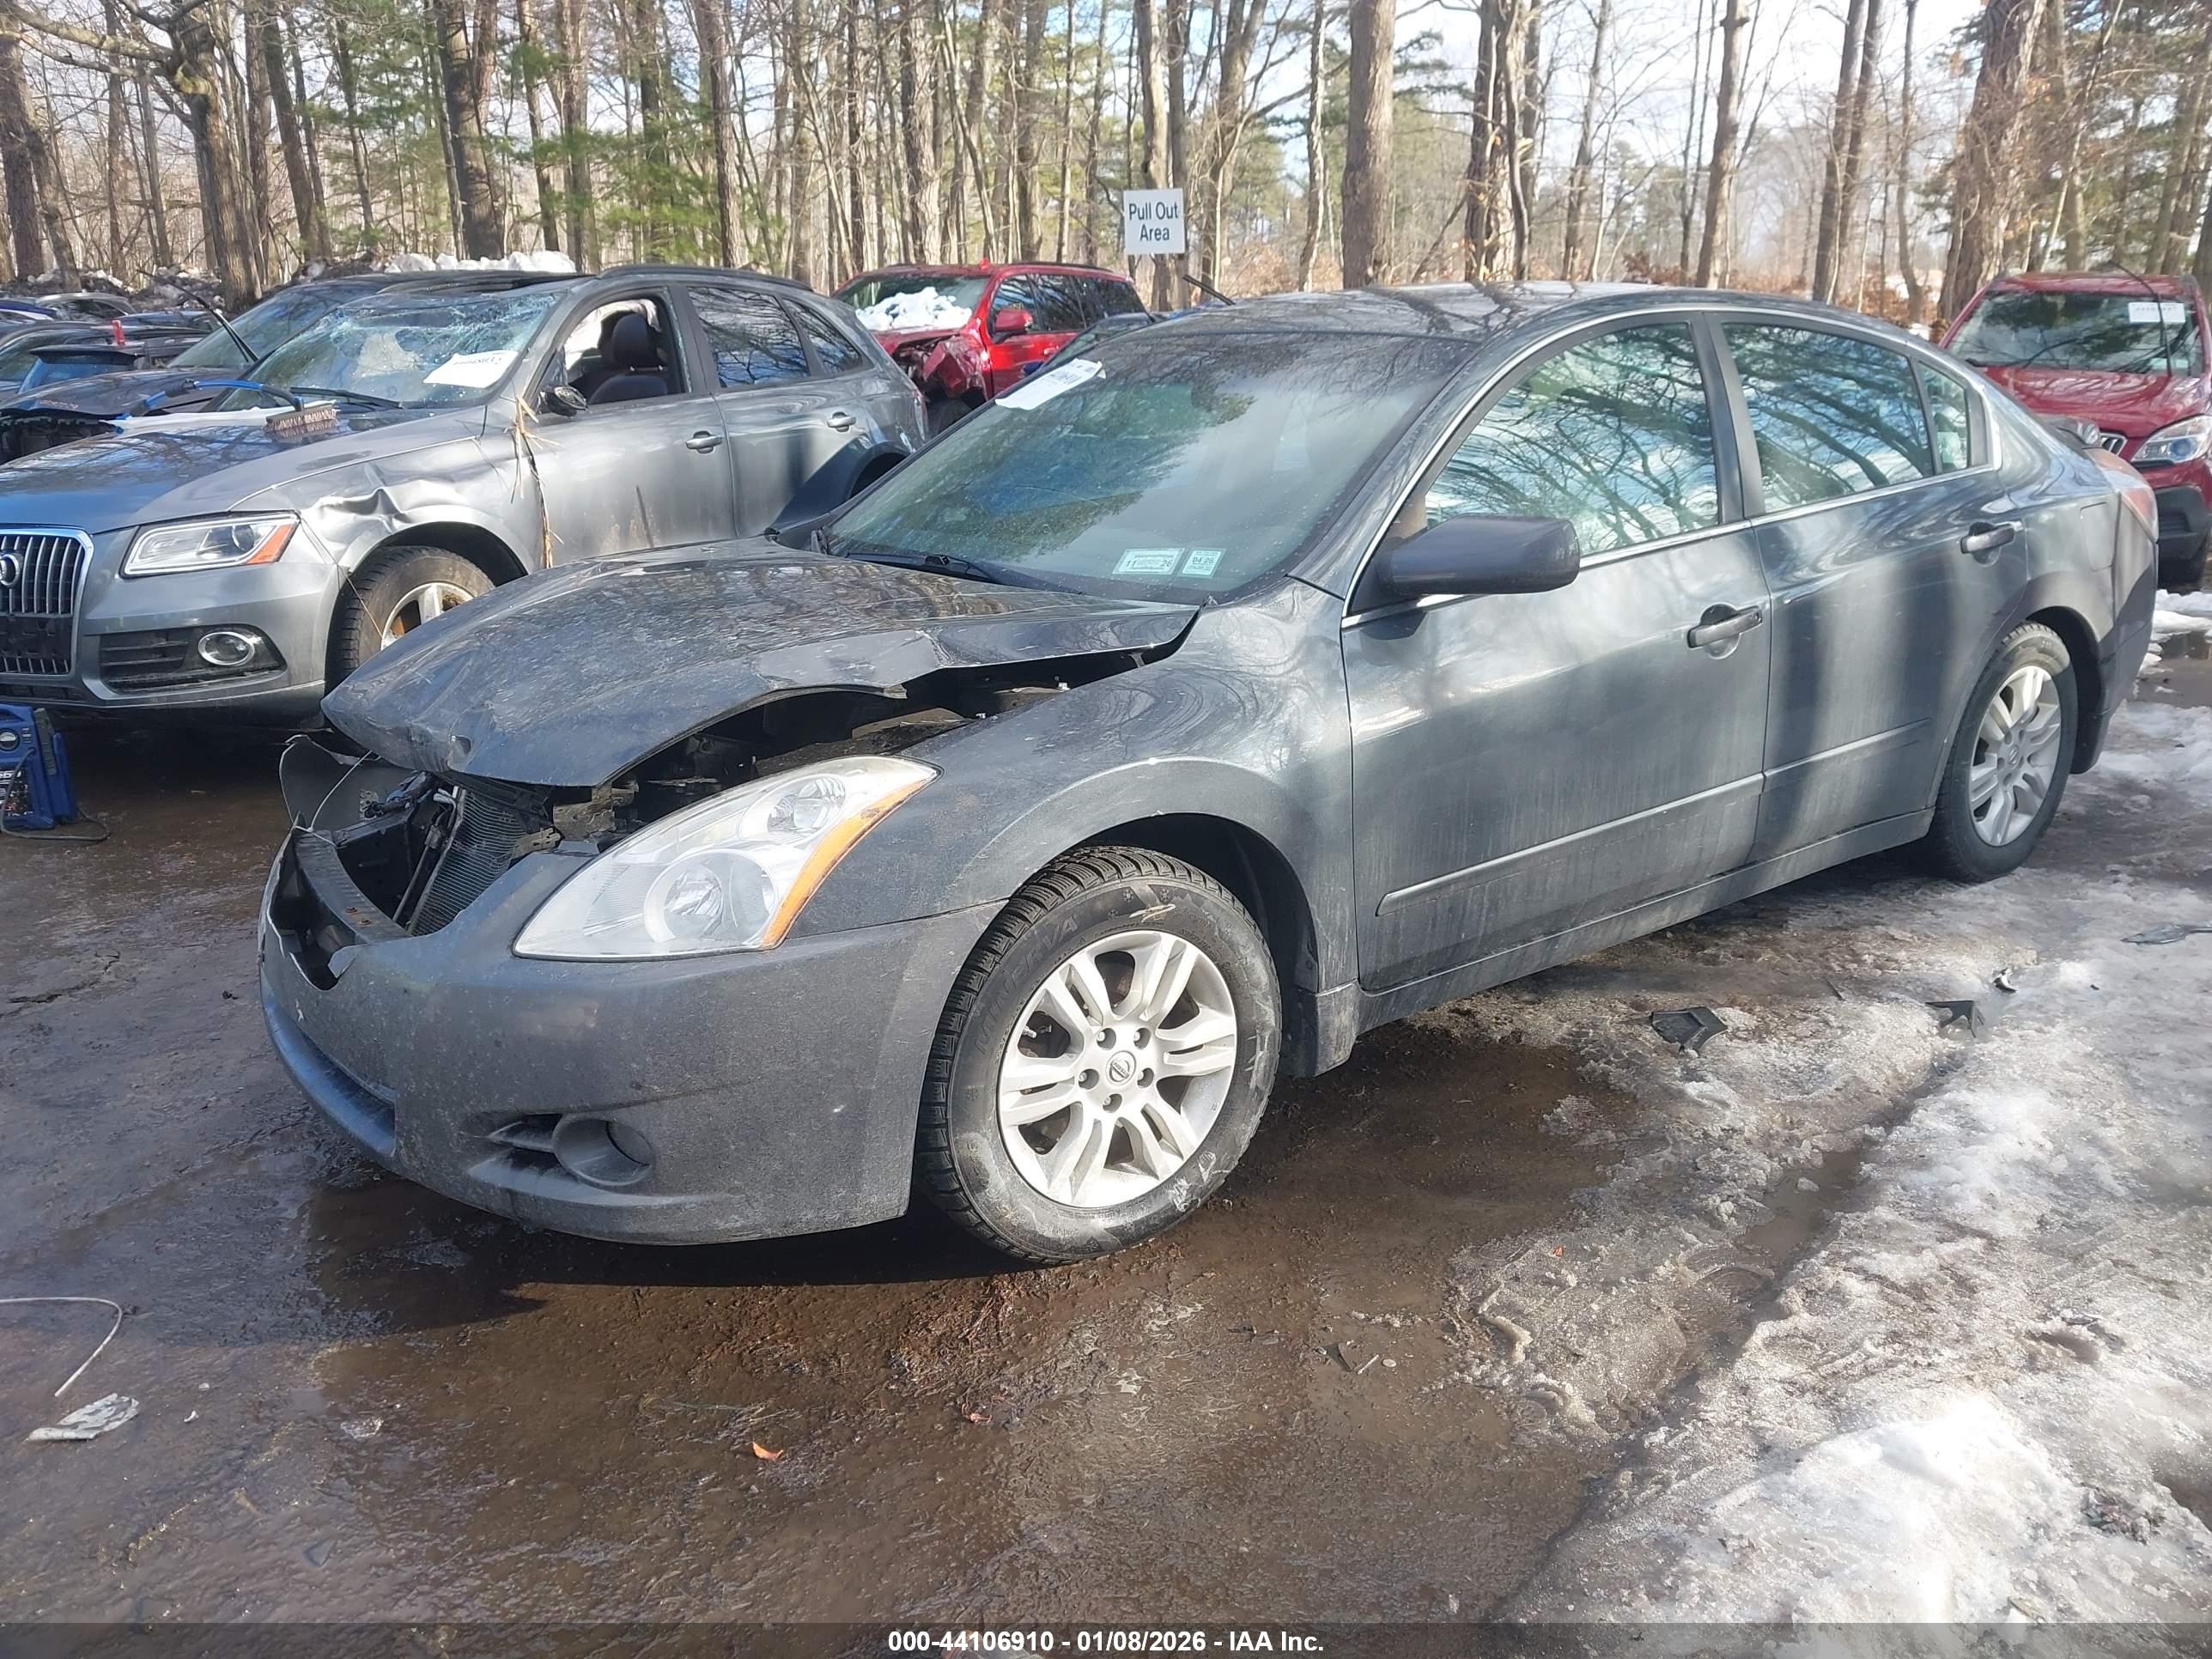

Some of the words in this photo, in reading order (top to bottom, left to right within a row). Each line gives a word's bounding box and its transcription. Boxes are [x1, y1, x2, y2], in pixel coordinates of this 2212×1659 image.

[1128, 202, 1152, 221] Pull
[1155, 201, 1178, 220] Out
[1139, 224, 1170, 241] Area
